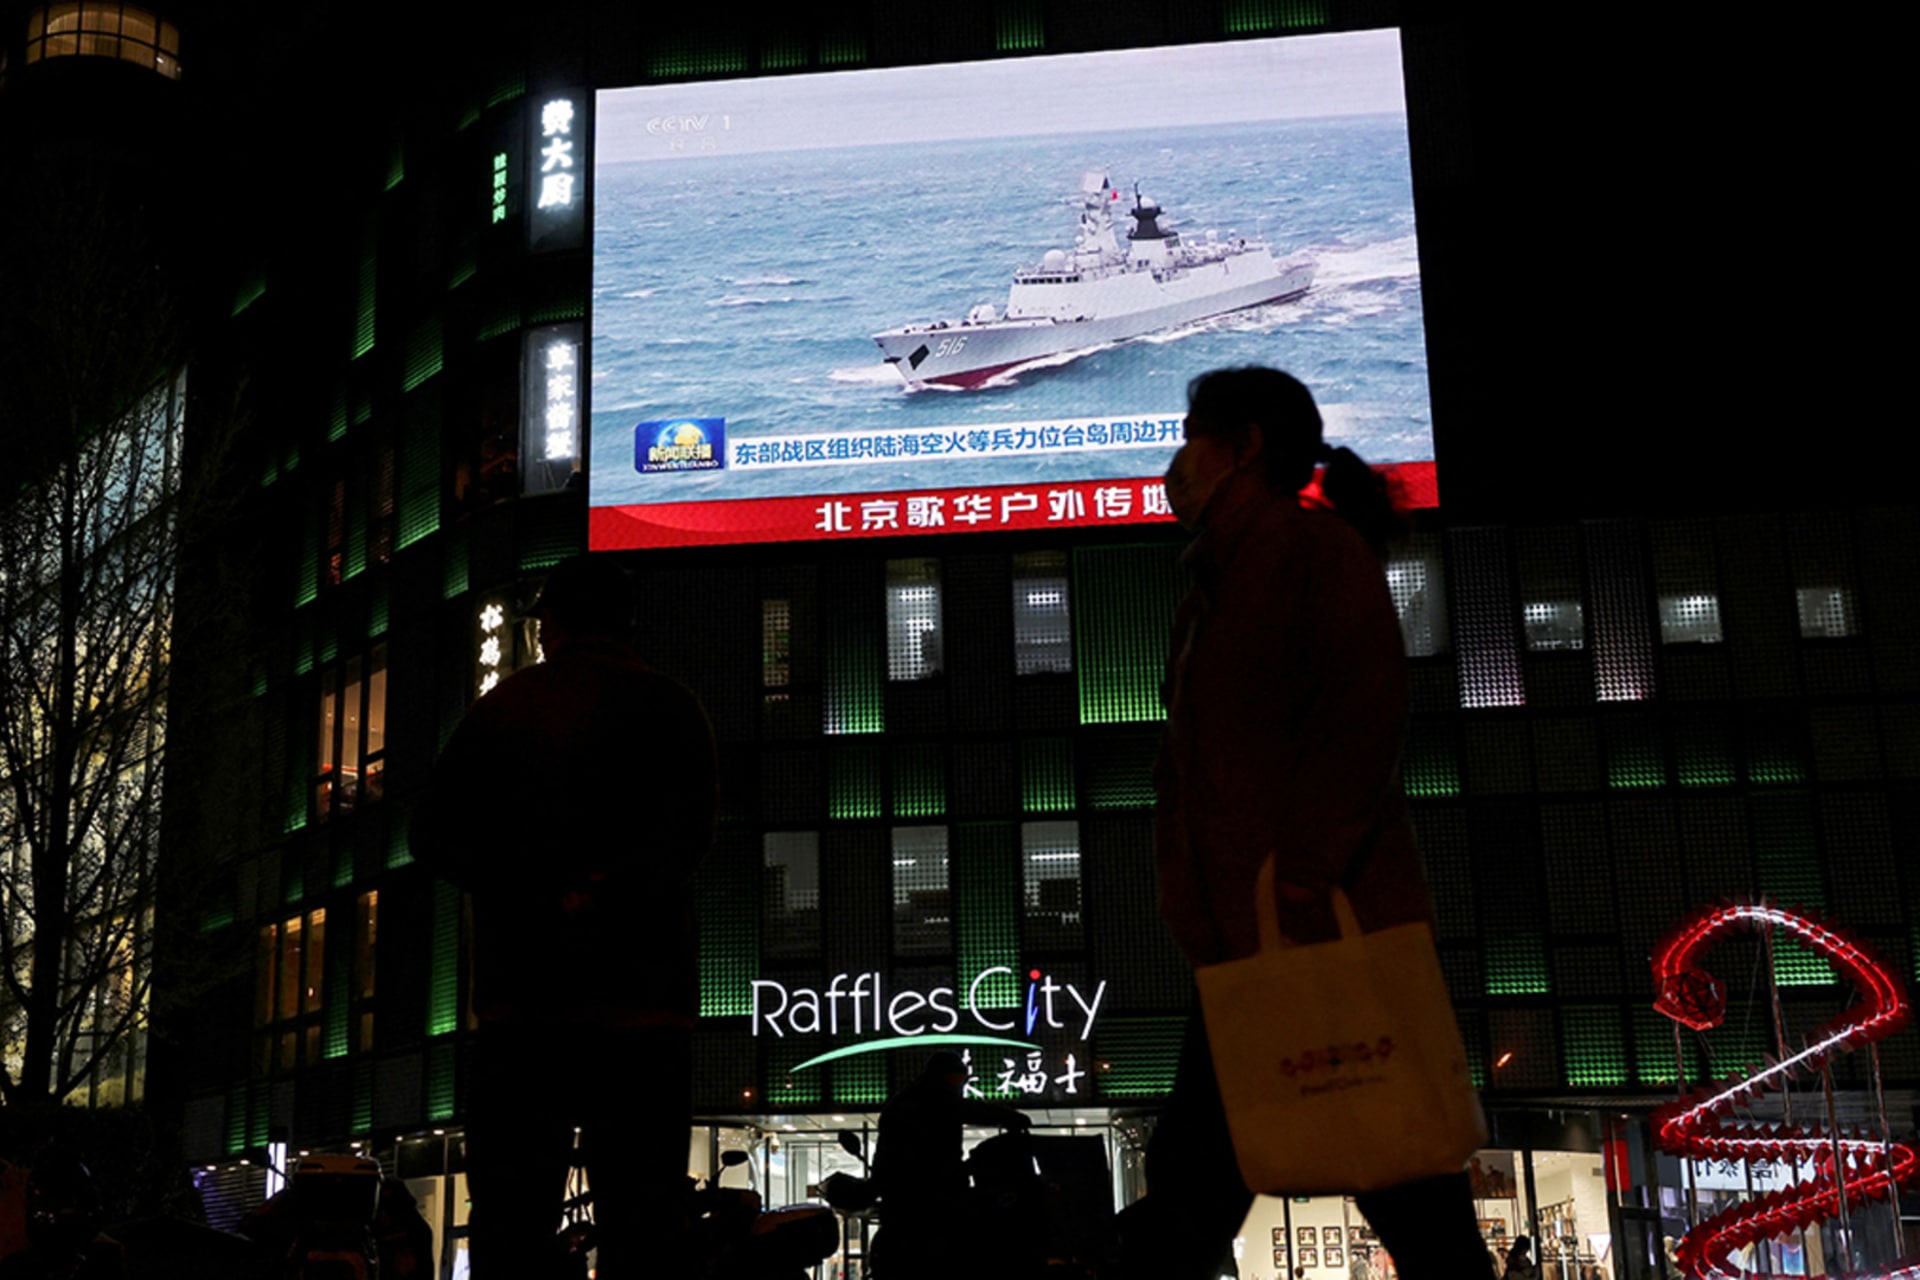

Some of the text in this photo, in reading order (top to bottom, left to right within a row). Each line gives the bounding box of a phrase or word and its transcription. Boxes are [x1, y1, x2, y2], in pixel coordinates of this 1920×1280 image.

[646, 113, 731, 136] CCTV 1
[935, 335, 968, 358] 516
[734, 419, 1181, 465] 东部战区组织陆海空火等兵力位台岛周边开
[750, 966, 1107, 1041] Raffles City
